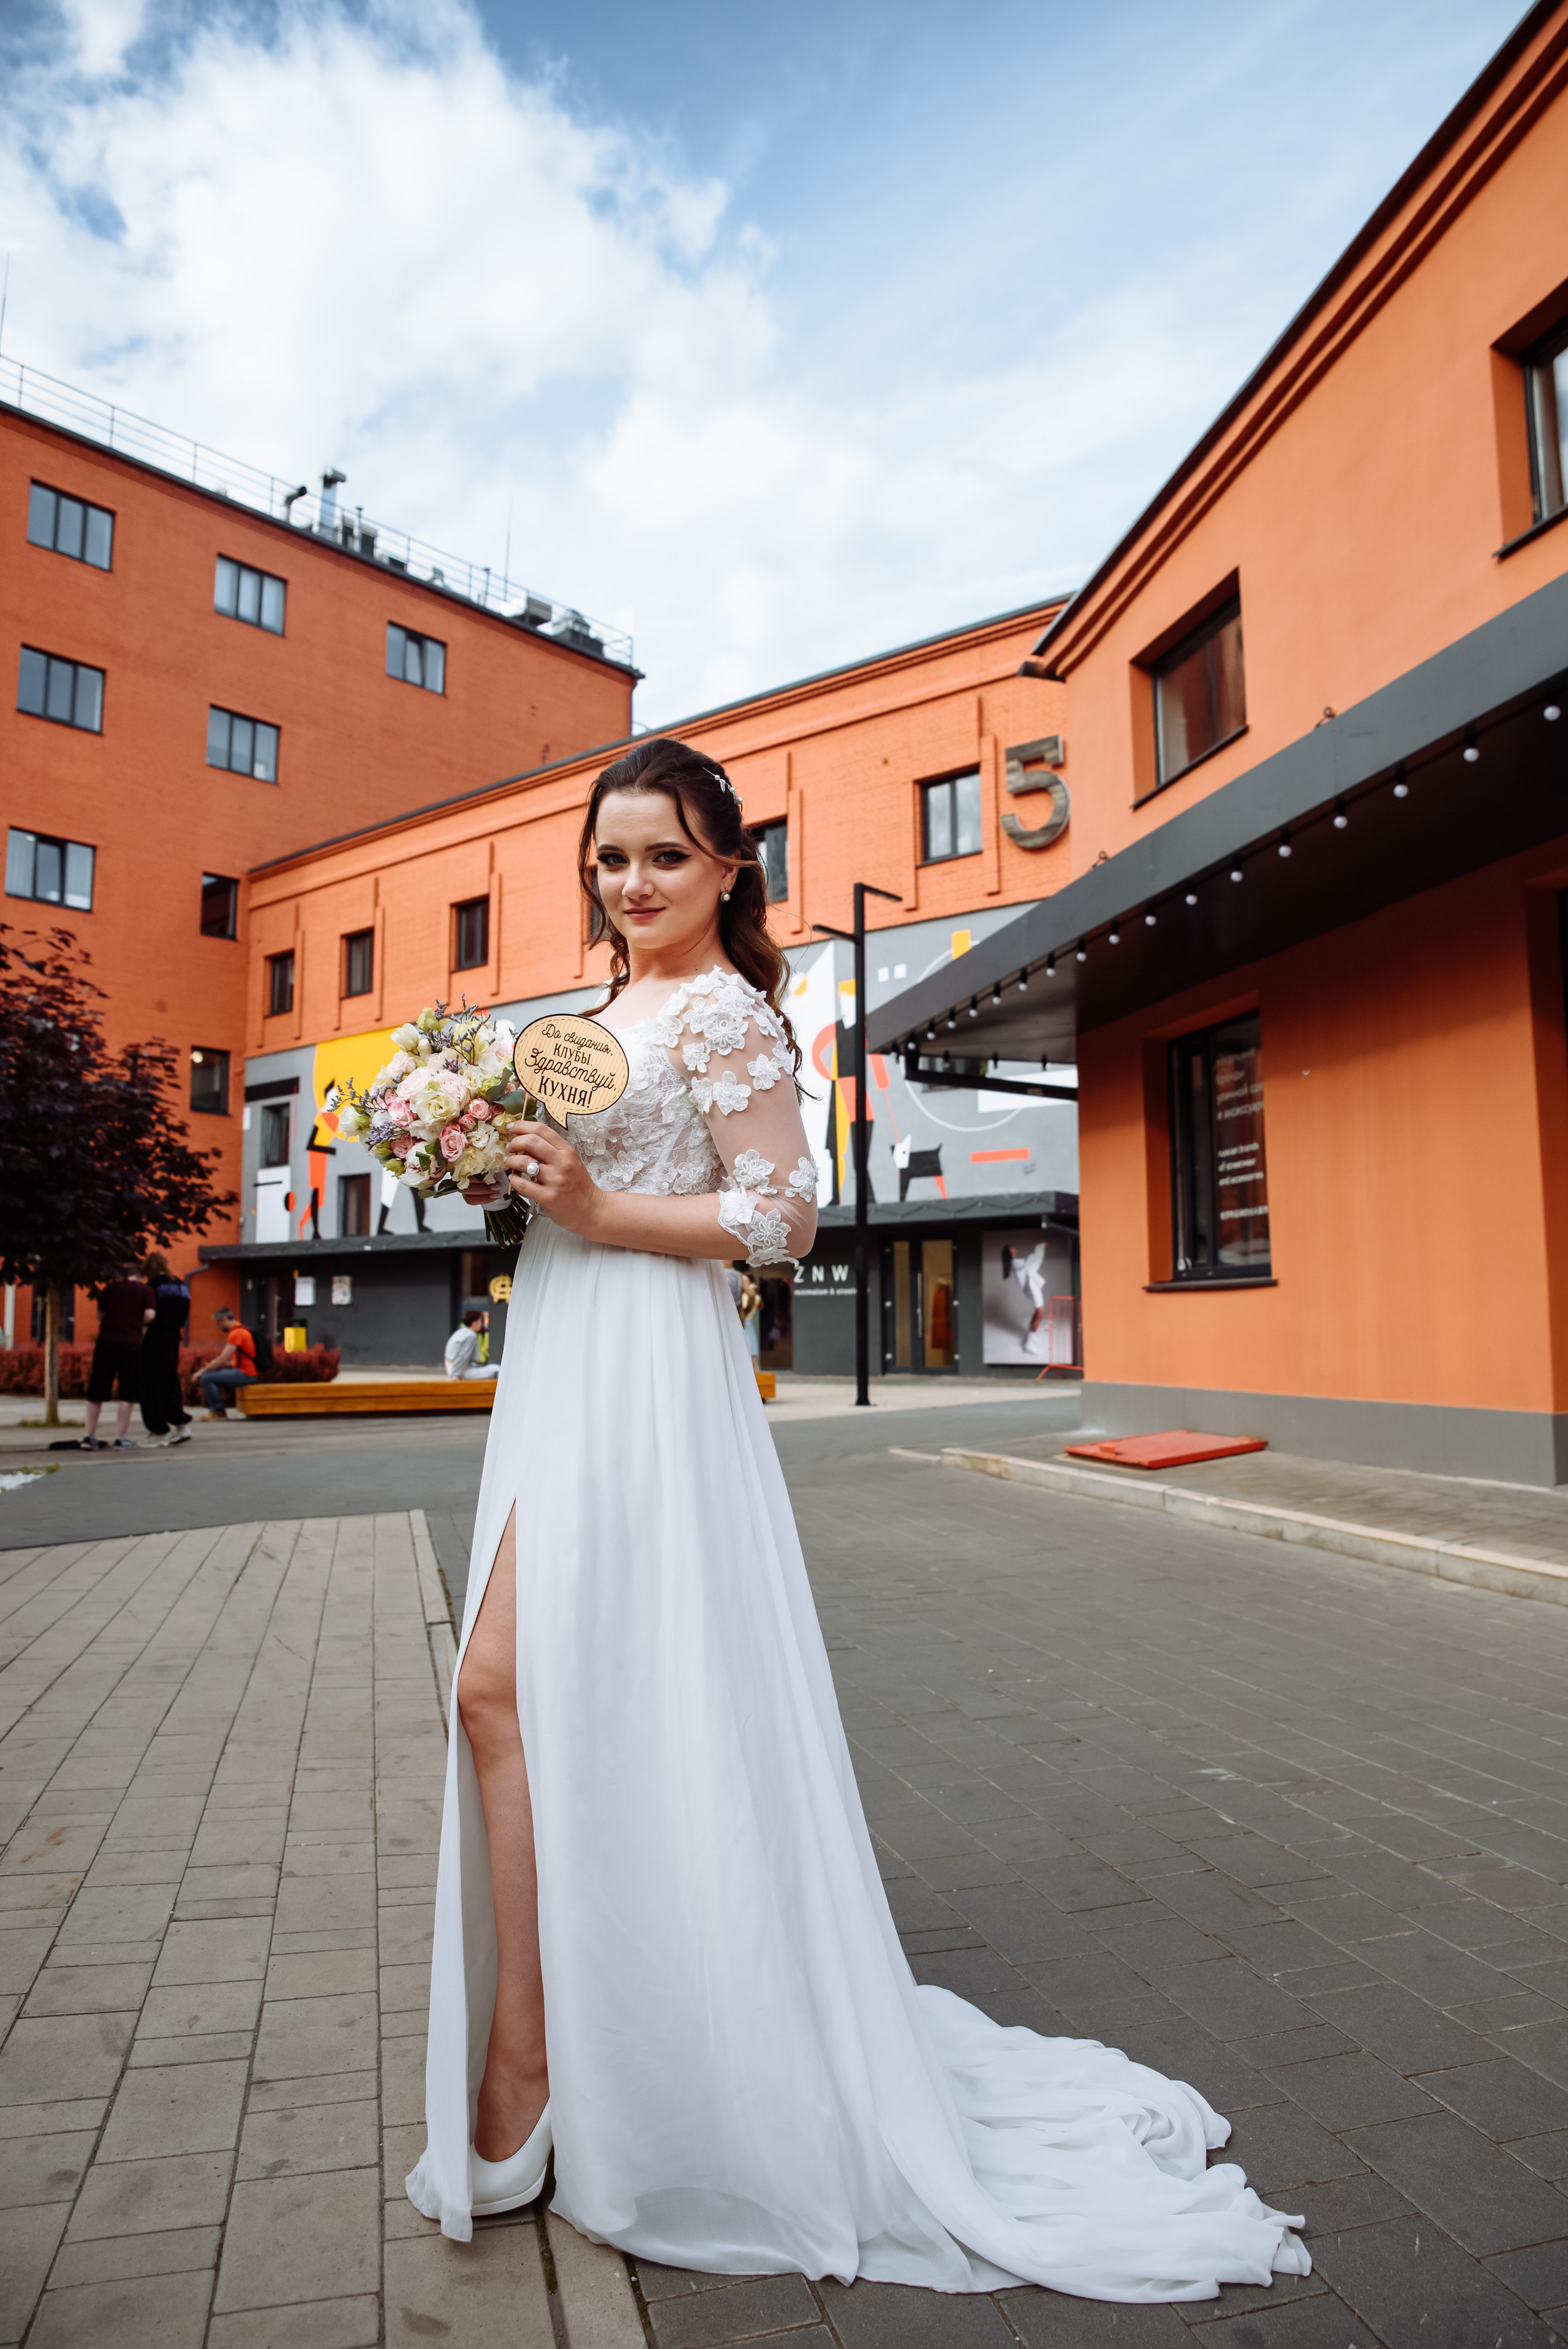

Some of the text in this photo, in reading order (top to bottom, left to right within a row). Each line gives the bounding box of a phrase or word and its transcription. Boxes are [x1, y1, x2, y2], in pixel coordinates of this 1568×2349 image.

[1000, 735, 1070, 848] 5
[541, 1024, 613, 1056] До свидания,
[553, 1043, 593, 1066] КЛУБЫ.
[525, 1048, 616, 1091] Здравствуй,
[538, 1075, 594, 1108] КУХНЯ!
